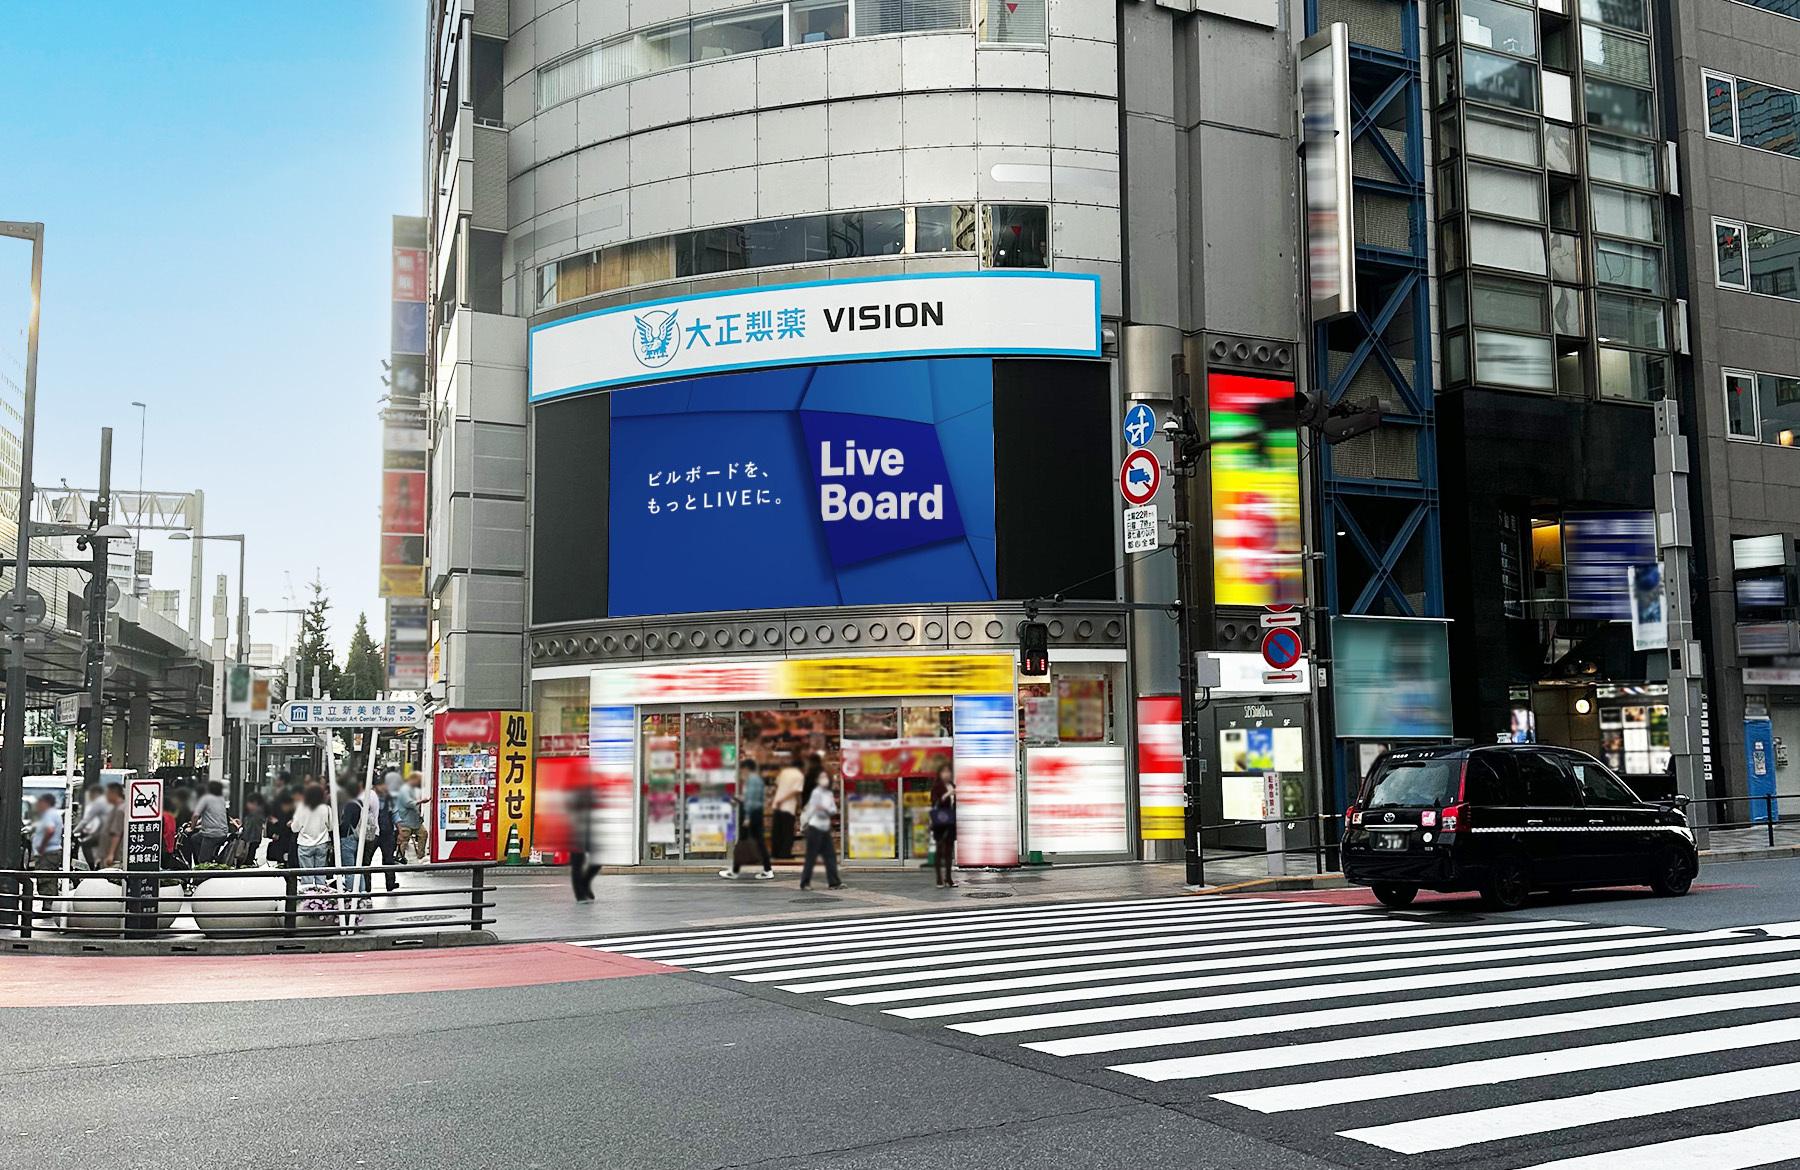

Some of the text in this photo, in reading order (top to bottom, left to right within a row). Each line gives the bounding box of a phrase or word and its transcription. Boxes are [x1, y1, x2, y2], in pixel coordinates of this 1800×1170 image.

[685, 301, 943, 350] 大正製薬 VISION
[820, 439, 905, 477] Live
[648, 461, 769, 487] ビルボードを、
[647, 489, 782, 515] もっとLIVEに。
[820, 483, 944, 522] Board
[313, 705, 396, 716] 国立新美術館
[129, 823, 160, 833] 交差点内
[129, 834, 145, 843] では
[129, 844, 159, 853] タクシーの
[129, 854, 159, 864] 乗降禁止
